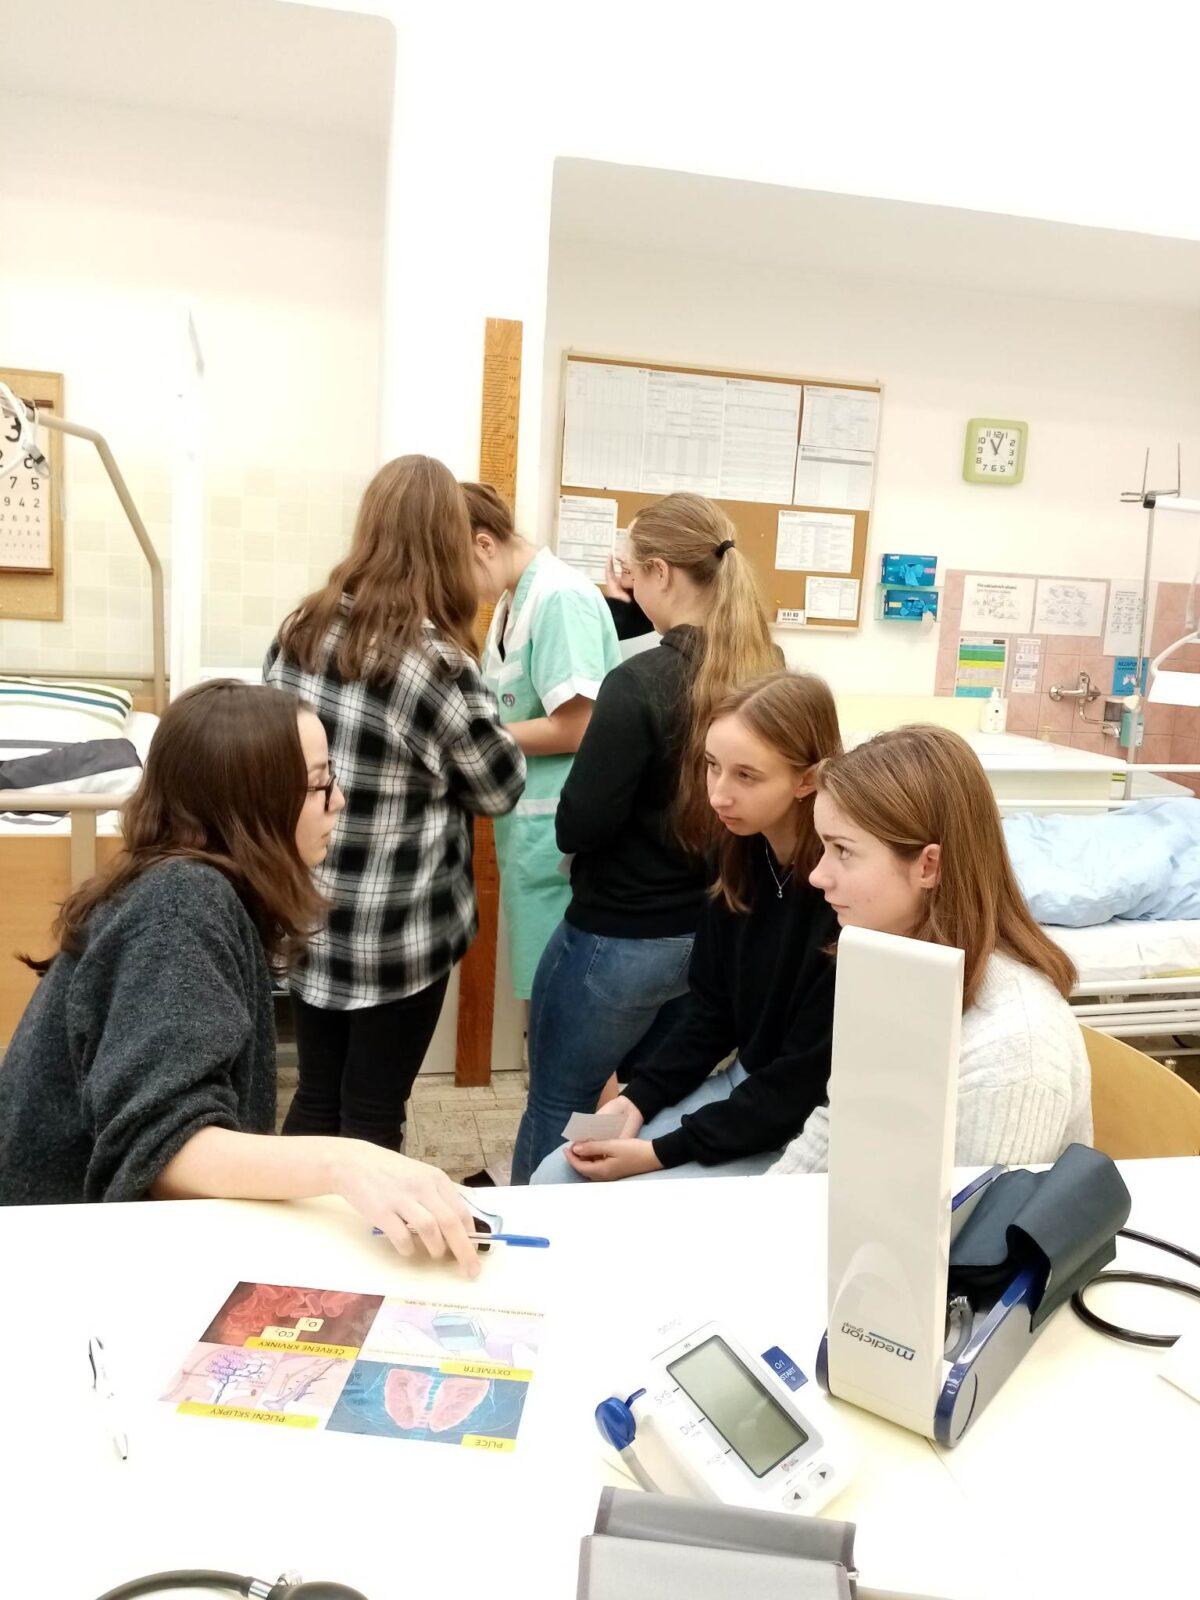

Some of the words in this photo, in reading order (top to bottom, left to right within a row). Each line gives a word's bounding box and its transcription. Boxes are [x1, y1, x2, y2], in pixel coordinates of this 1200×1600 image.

[990, 464, 997, 472] 6
[1000, 465, 1006, 473] 5
[9, 476, 18, 489] 7
[31, 477, 39, 490] 5
[4, 496, 10, 506] 9
[19, 497, 25, 507] 4
[33, 497, 40, 508] 2
[841, 1325, 915, 1361] medicton
[463, 1365, 512, 1376] OXYMETR
[780, 1366, 797, 1381] START
